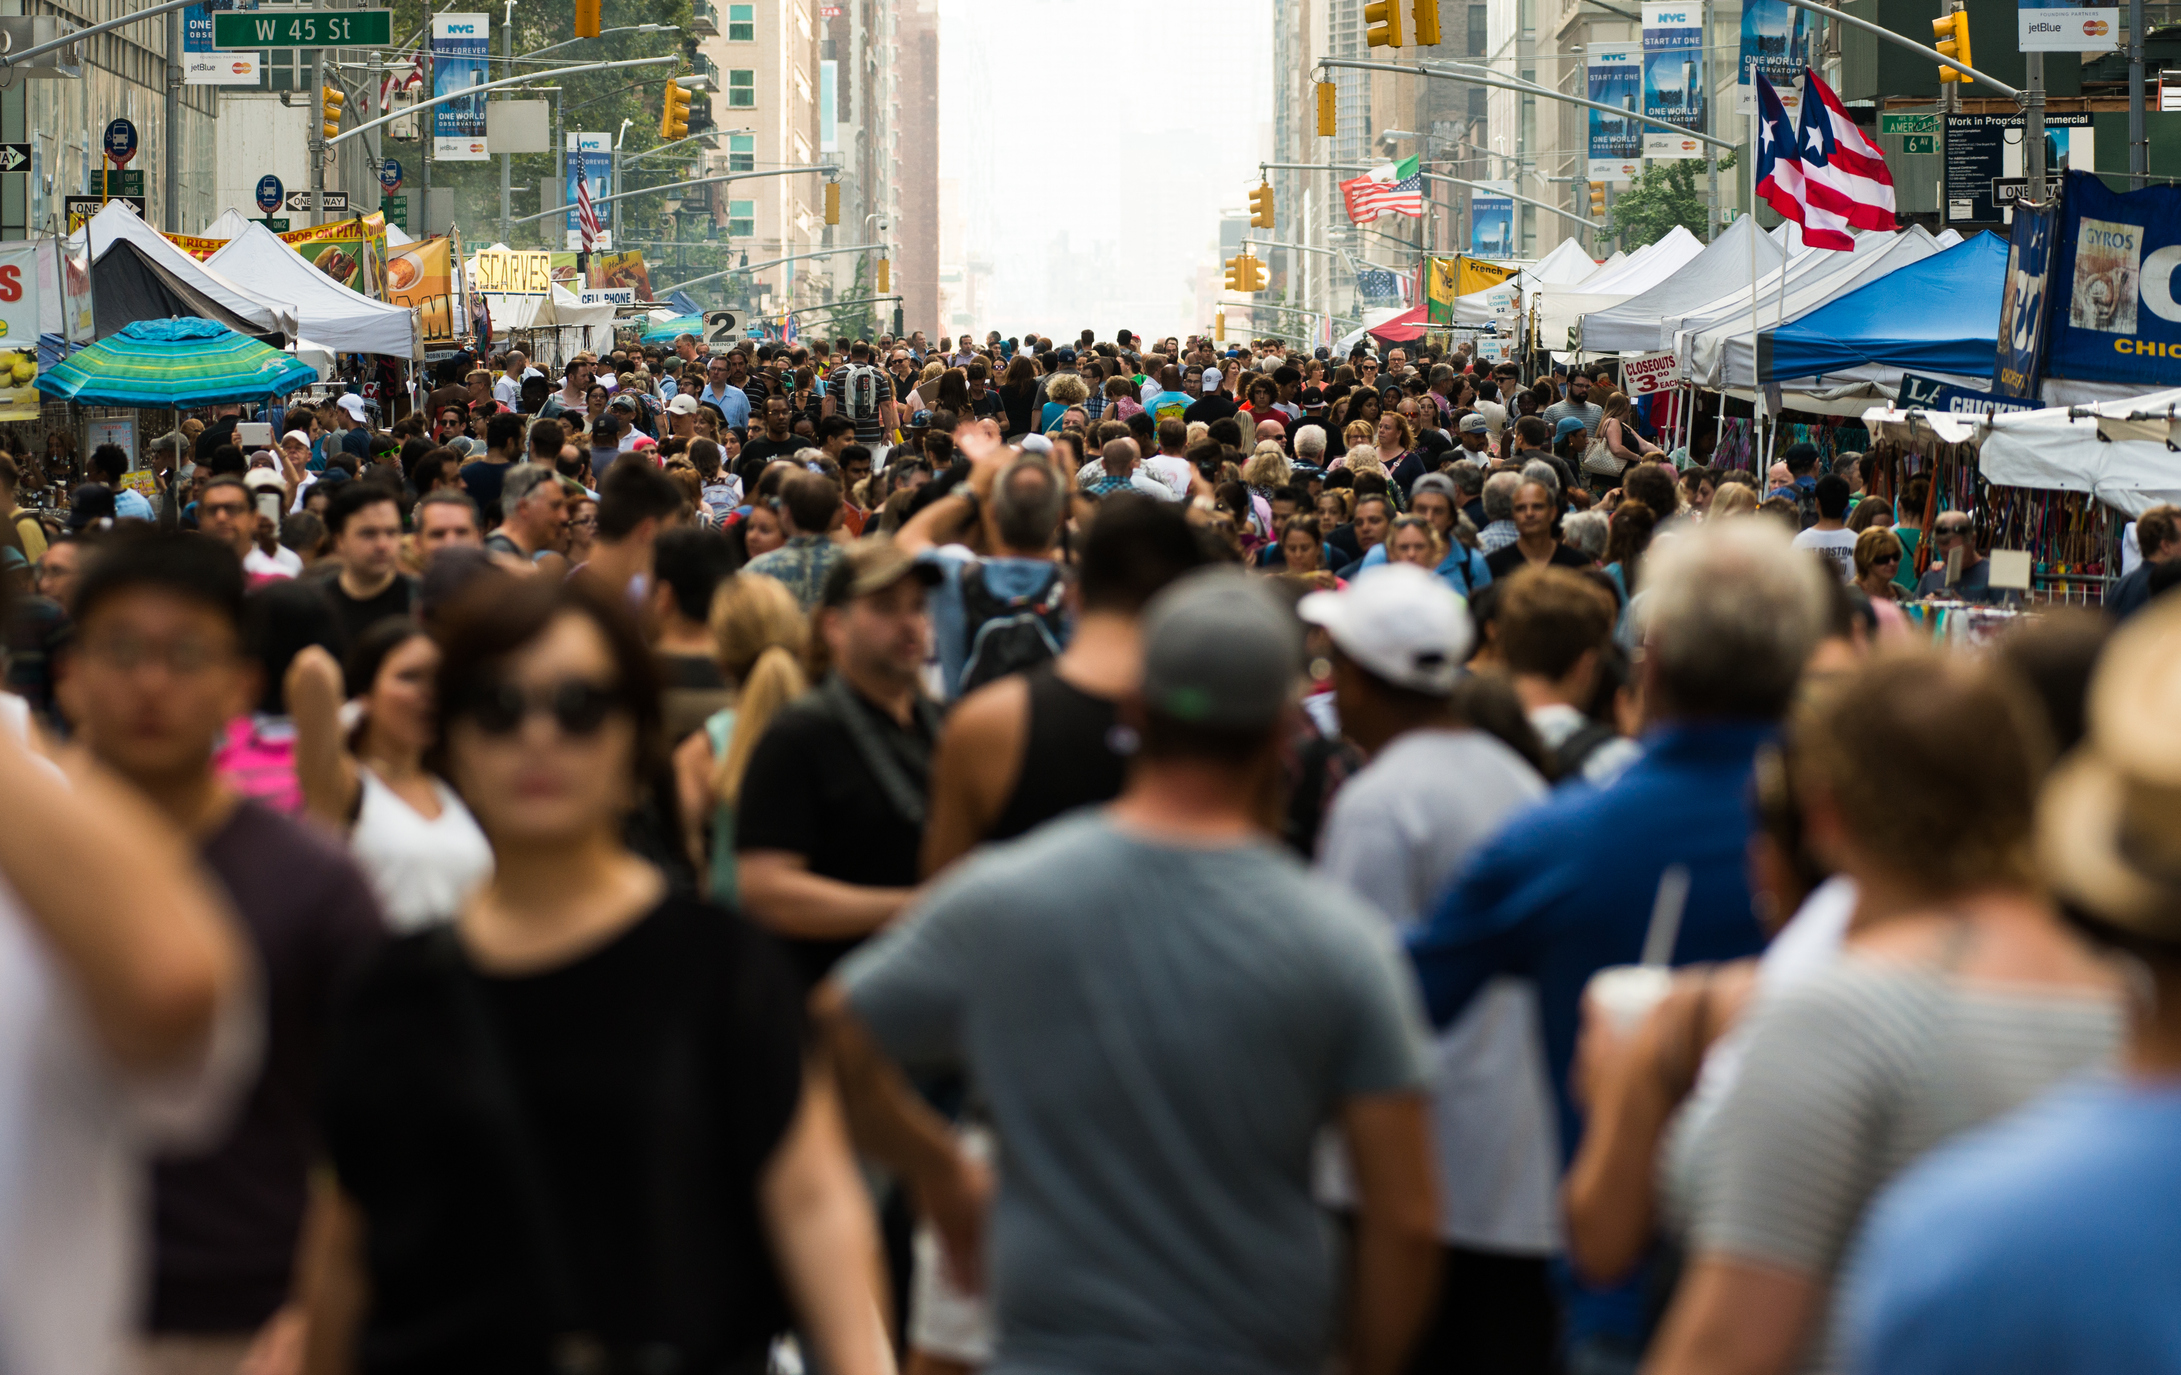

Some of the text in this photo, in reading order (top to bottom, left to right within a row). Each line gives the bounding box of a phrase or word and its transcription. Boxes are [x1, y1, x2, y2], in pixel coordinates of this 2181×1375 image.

[1658, 13, 1686, 23] NYC
[190, 20, 212, 29] ONE
[256, 18, 350, 40] W 45 St
[448, 25, 474, 34] NYC
[2028, 23, 2061, 34] jetBlue
[1745, 55, 1802, 66] ONE WORLD
[190, 63, 216, 72] jetBlue
[1745, 66, 1801, 74] OSERVATORY
[1948, 117, 1971, 125] Work
[1974, 117, 1982, 125] in
[2044, 115, 2088, 124] mmercial
[1890, 122, 1933, 132] AMERICAS
[1909, 137, 1917, 152] 6
[0, 152, 18, 163] AY
[125, 172, 138, 182] QM1
[125, 186, 138, 195] QM5
[2006, 186, 2028, 197] ONE
[294, 197, 343, 206] ONE WAY
[76, 203, 99, 214] ONE
[273, 220, 286, 229] QM2
[316, 229, 333, 239] ON
[336, 223, 362, 238] PITA
[187, 238, 214, 248] RICE
[2086, 228, 2134, 250] GYROS
[480, 253, 549, 291] SCARVES
[1470, 262, 1503, 275] French
[604, 292, 631, 303] PHONE
[704, 312, 735, 342] $2
[1625, 355, 1676, 376] CLOSEOUTS
[1660, 379, 1680, 388] EACH
[1950, 396, 2032, 414] CHICK
[1819, 546, 1854, 557] BOSTON
